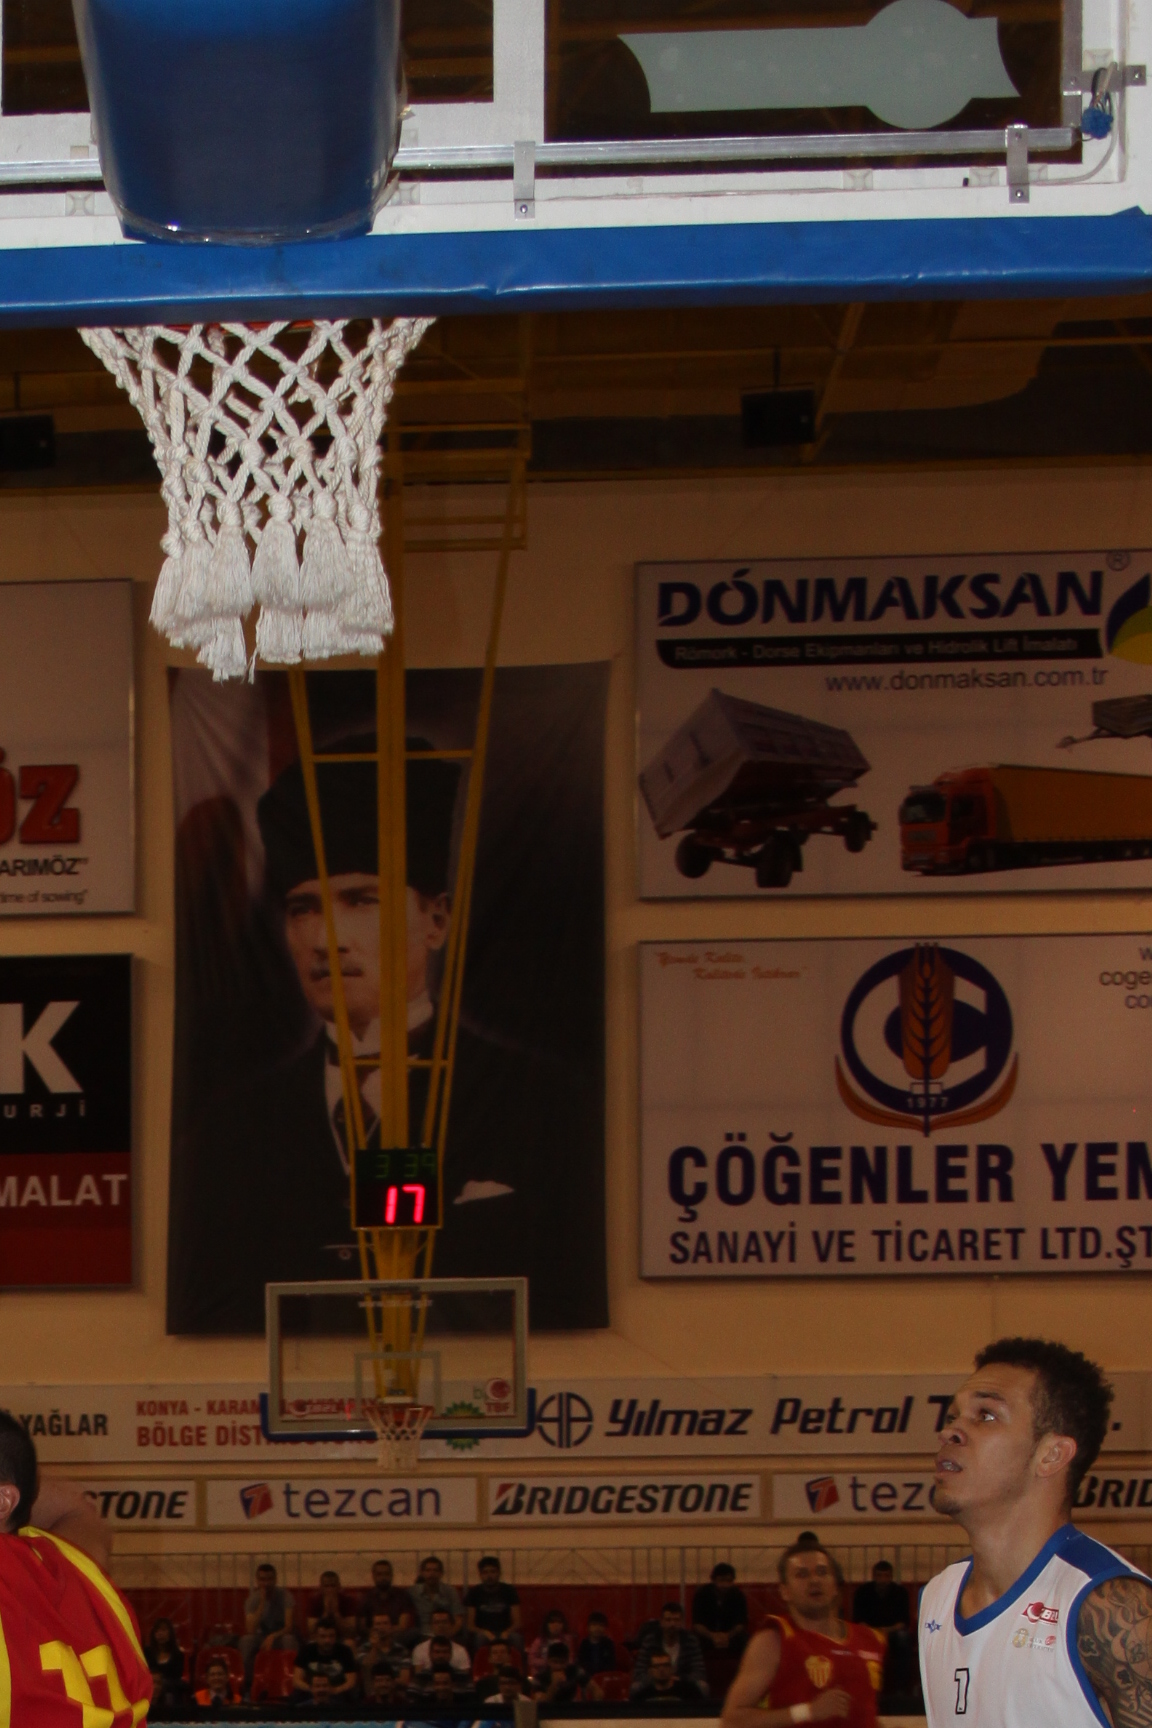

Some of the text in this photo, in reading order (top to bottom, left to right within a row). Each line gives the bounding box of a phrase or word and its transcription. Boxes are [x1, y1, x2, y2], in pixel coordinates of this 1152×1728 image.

[826, 668, 1108, 693] www.donmaksan.com.tr
[668, 1131, 1015, 1223] ÇÖĞENLER
[385, 1183, 427, 1225] 17
[669, 1221, 797, 1264] SANAYİ
[813, 1230, 856, 1263] VE
[872, 1220, 1026, 1263] TİCARET
[137, 1399, 189, 1416] KONYA
[770, 1395, 913, 1435] Petrol
[137, 1421, 207, 1447] BÖLGE
[285, 1482, 441, 1518] tezcan
[491, 1482, 753, 1516] BRIDGESTONE
[954, 1667, 970, 1715] 1
